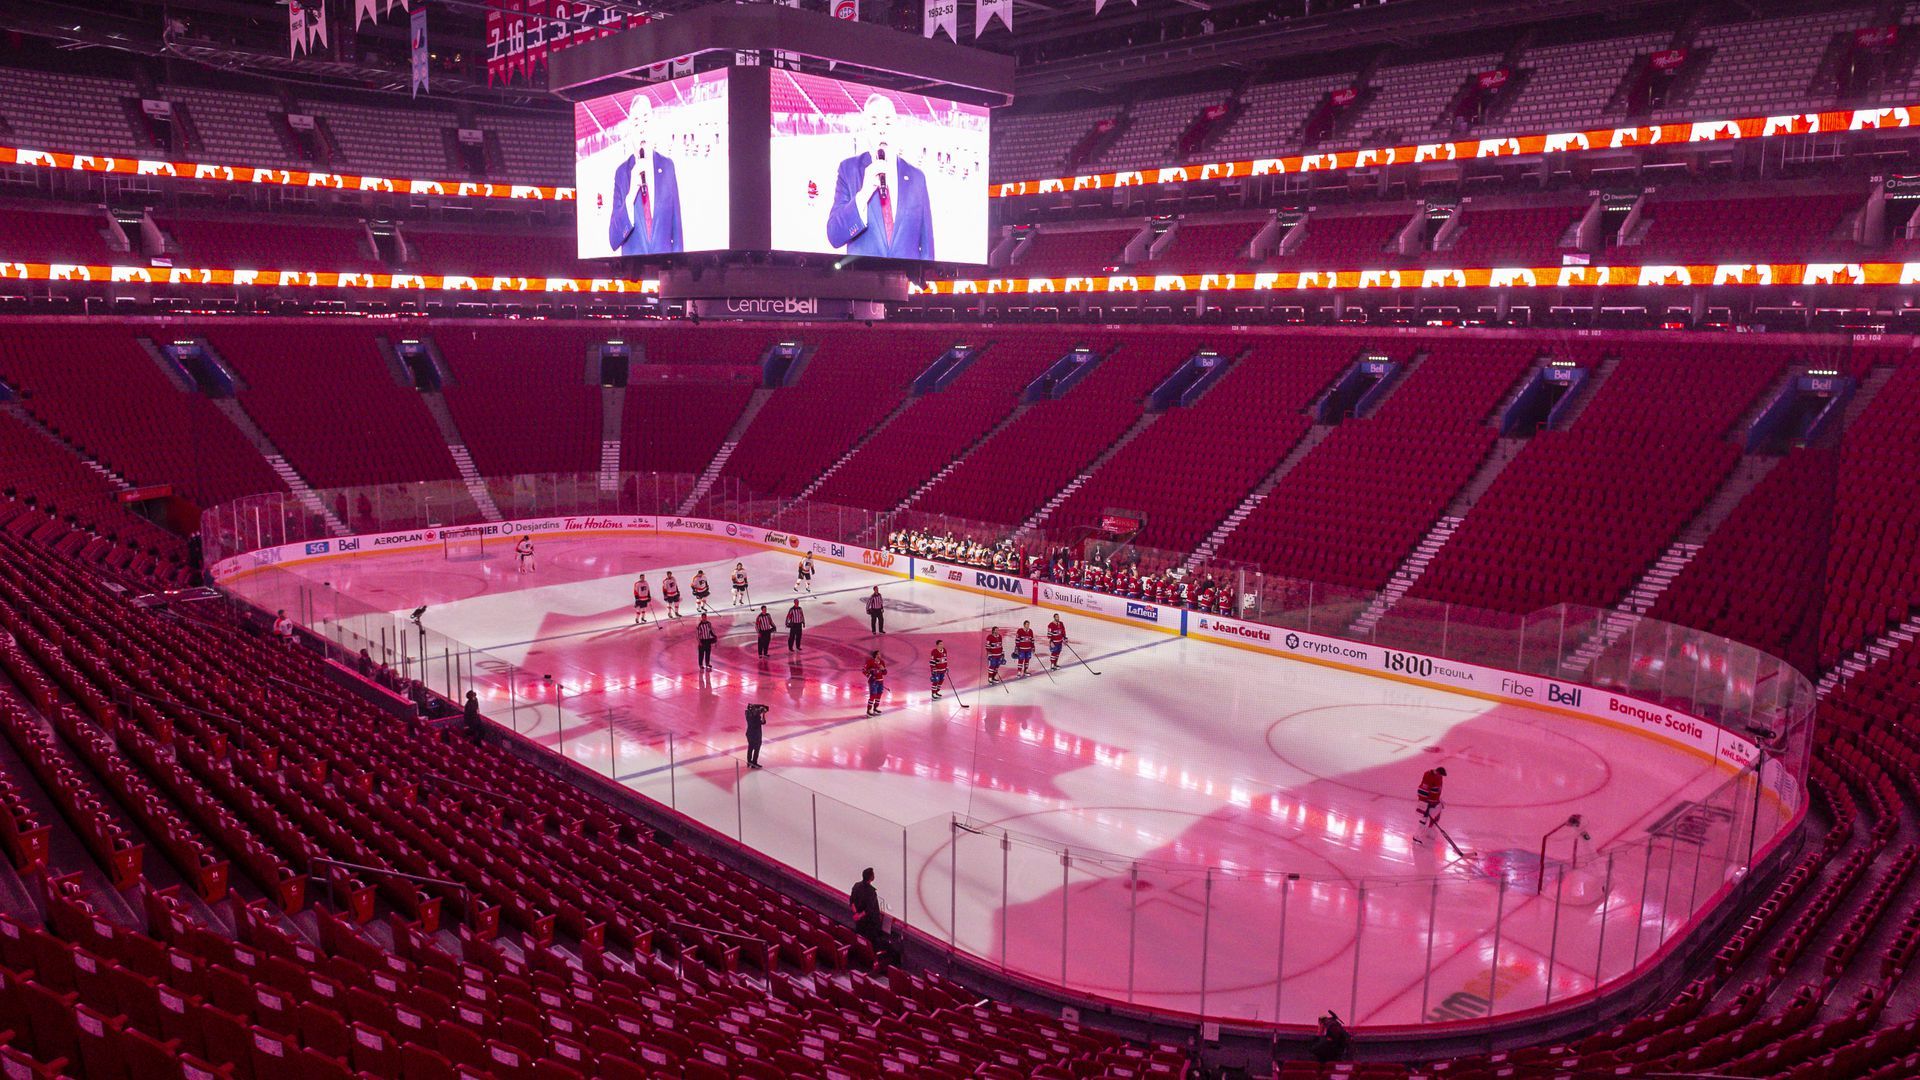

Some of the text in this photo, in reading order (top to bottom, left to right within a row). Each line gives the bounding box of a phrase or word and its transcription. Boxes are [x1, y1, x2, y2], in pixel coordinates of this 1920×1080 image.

[508, 20, 524, 55] 16
[1202, 359, 1214, 367] Bell
[1370, 363, 1384, 373] Bell
[1554, 369, 1571, 380] Bell
[1812, 379, 1832, 390] Bell
[515, 520, 560, 533] Desjardins
[564, 517, 623, 530] Tim Hortons
[338, 538, 360, 551] Bell
[374, 534, 422, 546] AEROPLAN
[310, 542, 325, 554] 5G
[812, 542, 845, 557] Fibe Bell
[872, 552, 895, 567] SKIP
[948, 570, 963, 581] IGA
[976, 572, 1023, 595] RONA
[1055, 590, 1068, 603] Sun
[1070, 593, 1084, 605] Life
[1128, 605, 1157, 618] Lafleur
[1303, 639, 1368, 661] crypto.com
[1383, 650, 1474, 681] 1800 TEQUILA
[1501, 678, 1582, 708] Fibe Bell
[1609, 698, 1703, 739] Banque Scotia
